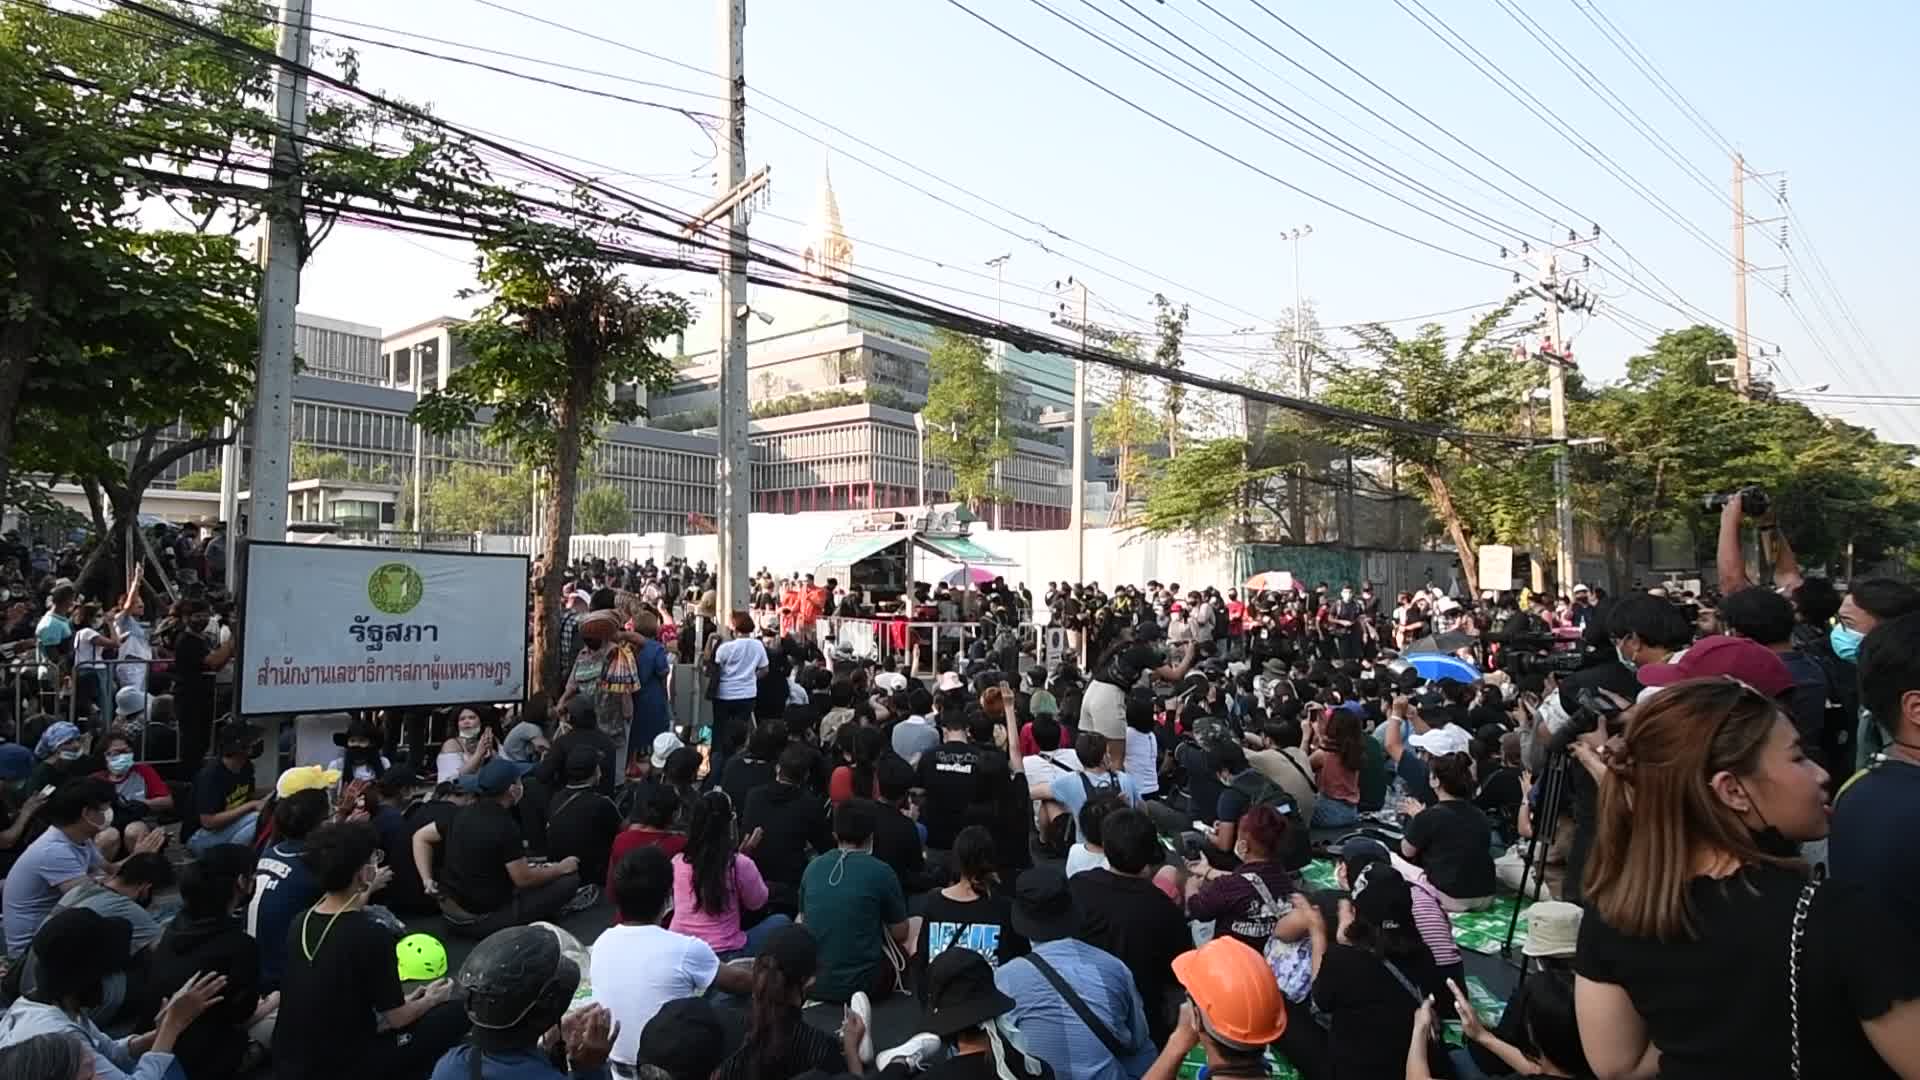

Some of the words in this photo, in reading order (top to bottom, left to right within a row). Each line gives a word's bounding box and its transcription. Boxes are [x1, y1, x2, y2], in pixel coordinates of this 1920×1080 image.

[349, 615, 438, 651] รัฐสภา
[257, 654, 511, 690] สำนักงานเลขาธิการสภาผู้แทนราษฎร
